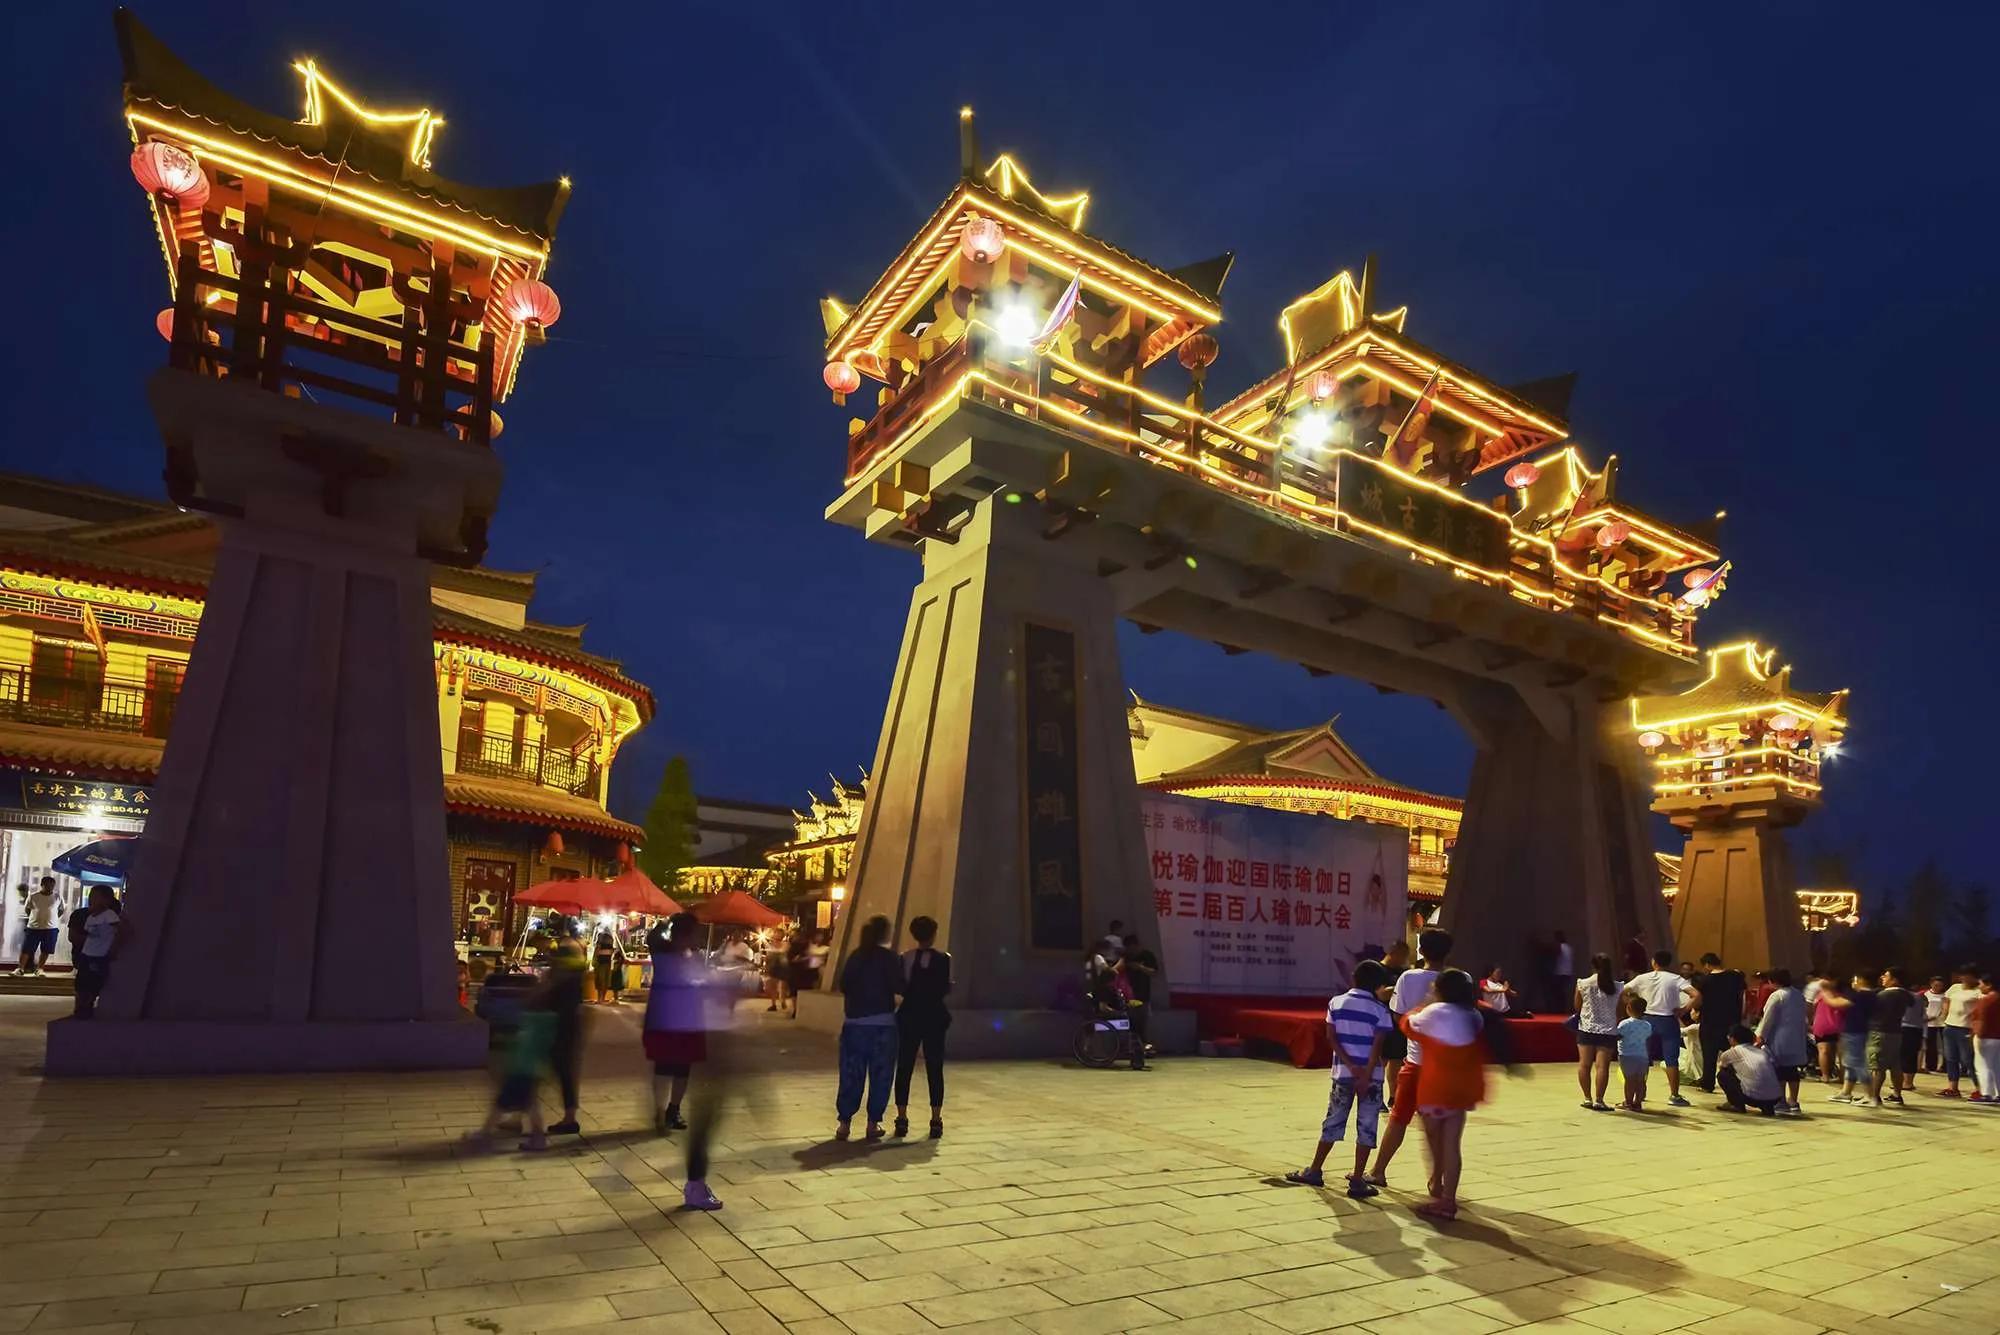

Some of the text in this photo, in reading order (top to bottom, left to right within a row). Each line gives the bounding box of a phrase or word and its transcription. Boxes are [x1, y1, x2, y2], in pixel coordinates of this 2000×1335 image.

[31, 783, 151, 803] 舌尖上的美食
[1152, 851, 1351, 895] 悦瑜伽迎国际瑜伽日
[1154, 888, 1352, 930] 第三届百人瑜伽大会
